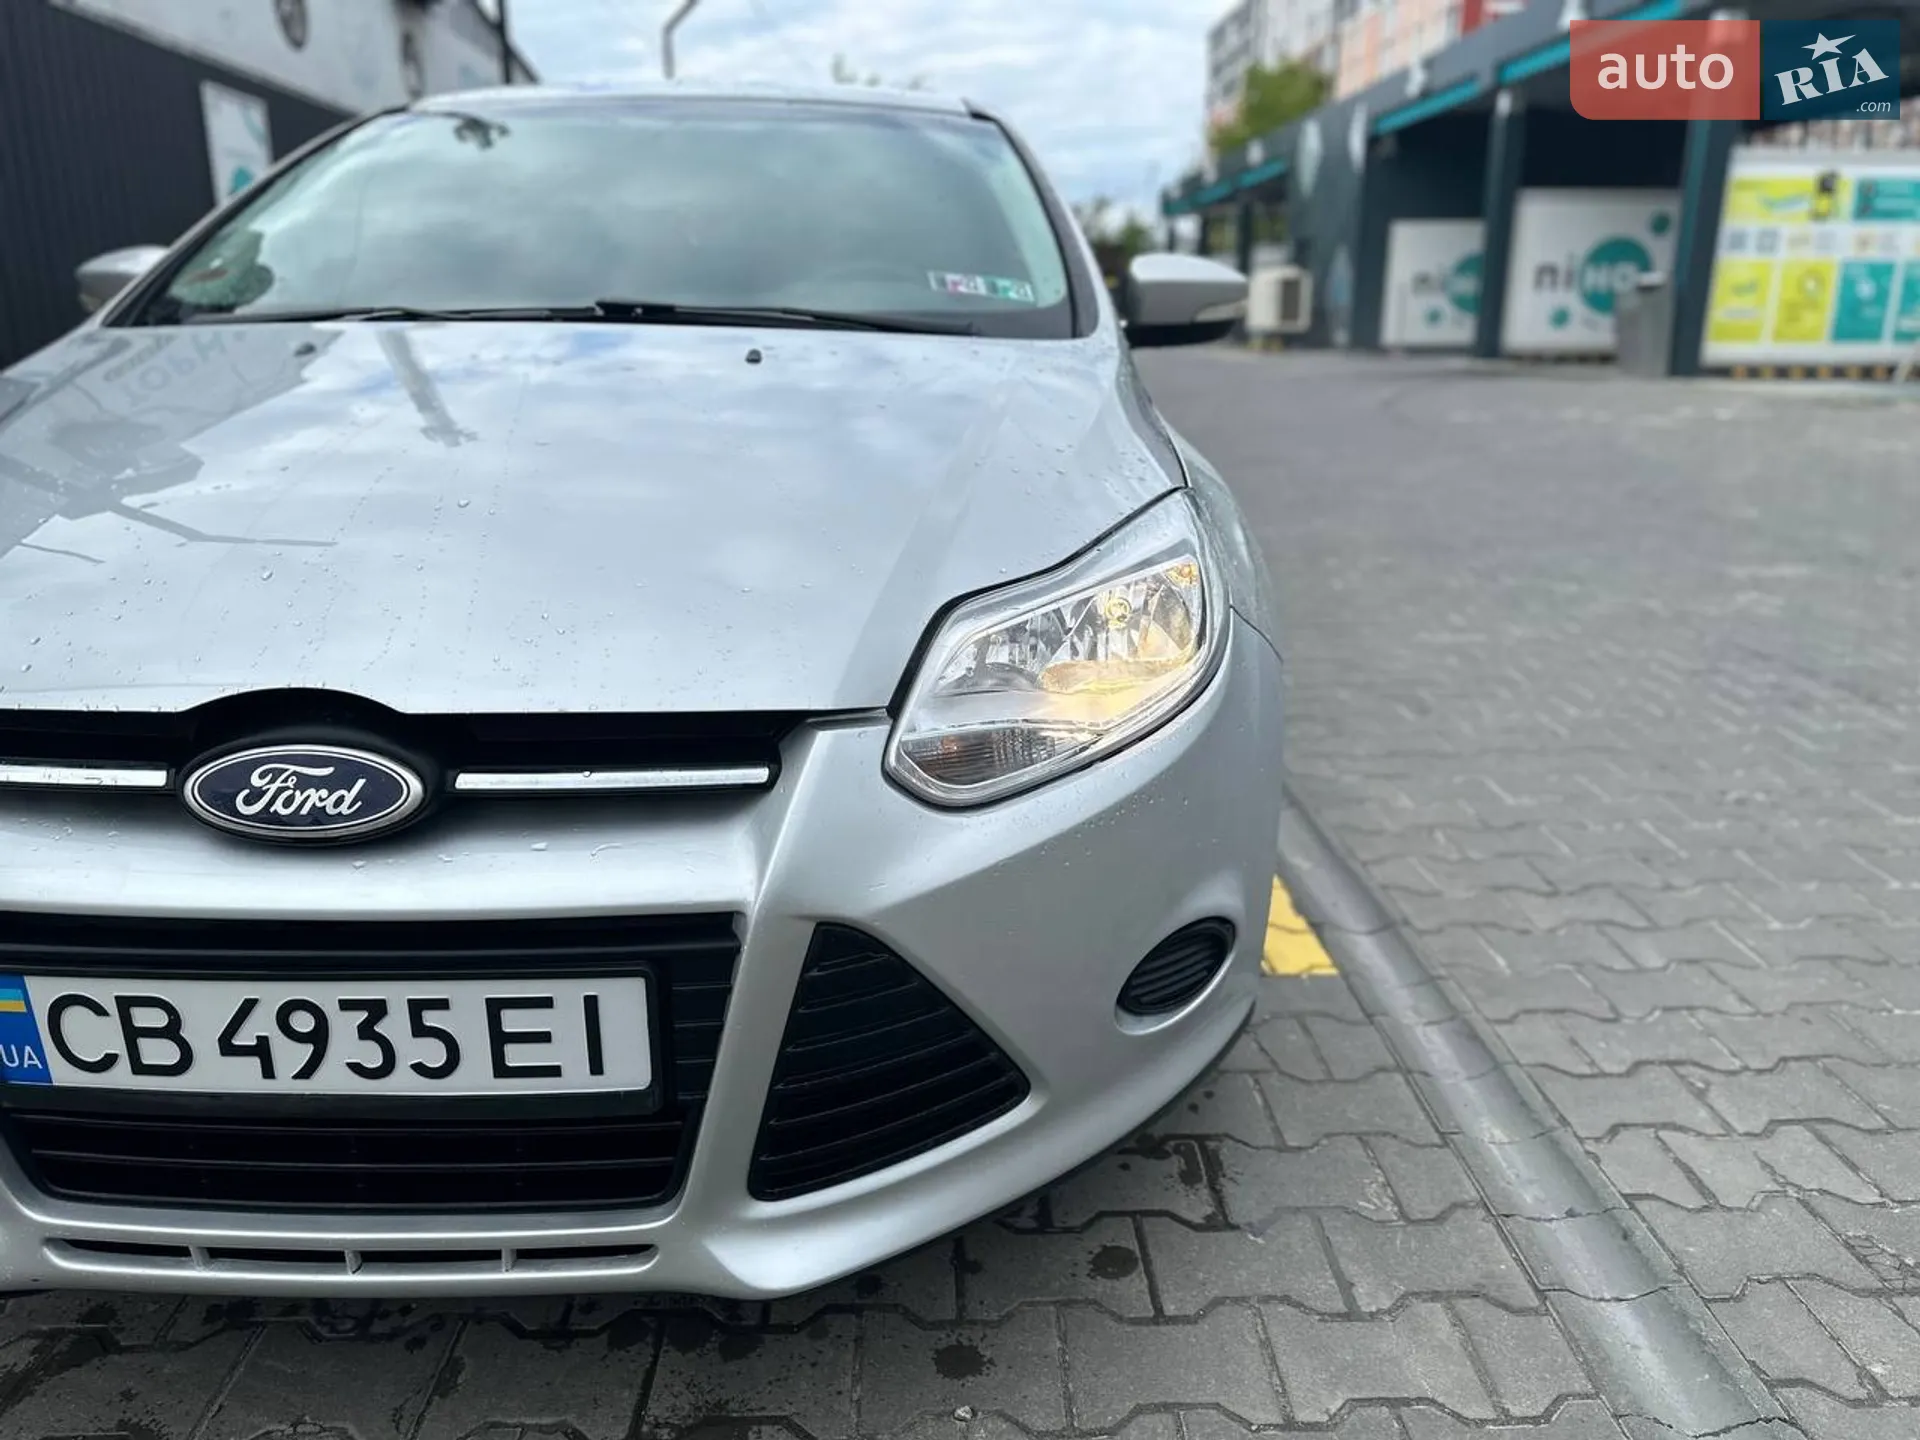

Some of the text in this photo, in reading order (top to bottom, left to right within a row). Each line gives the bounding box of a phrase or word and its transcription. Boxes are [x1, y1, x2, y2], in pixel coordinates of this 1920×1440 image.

[235, 763, 367, 816] Ford
[0, 1044, 43, 1069] UA
[47, 992, 194, 1077] CB
[217, 997, 460, 1080] 4935
